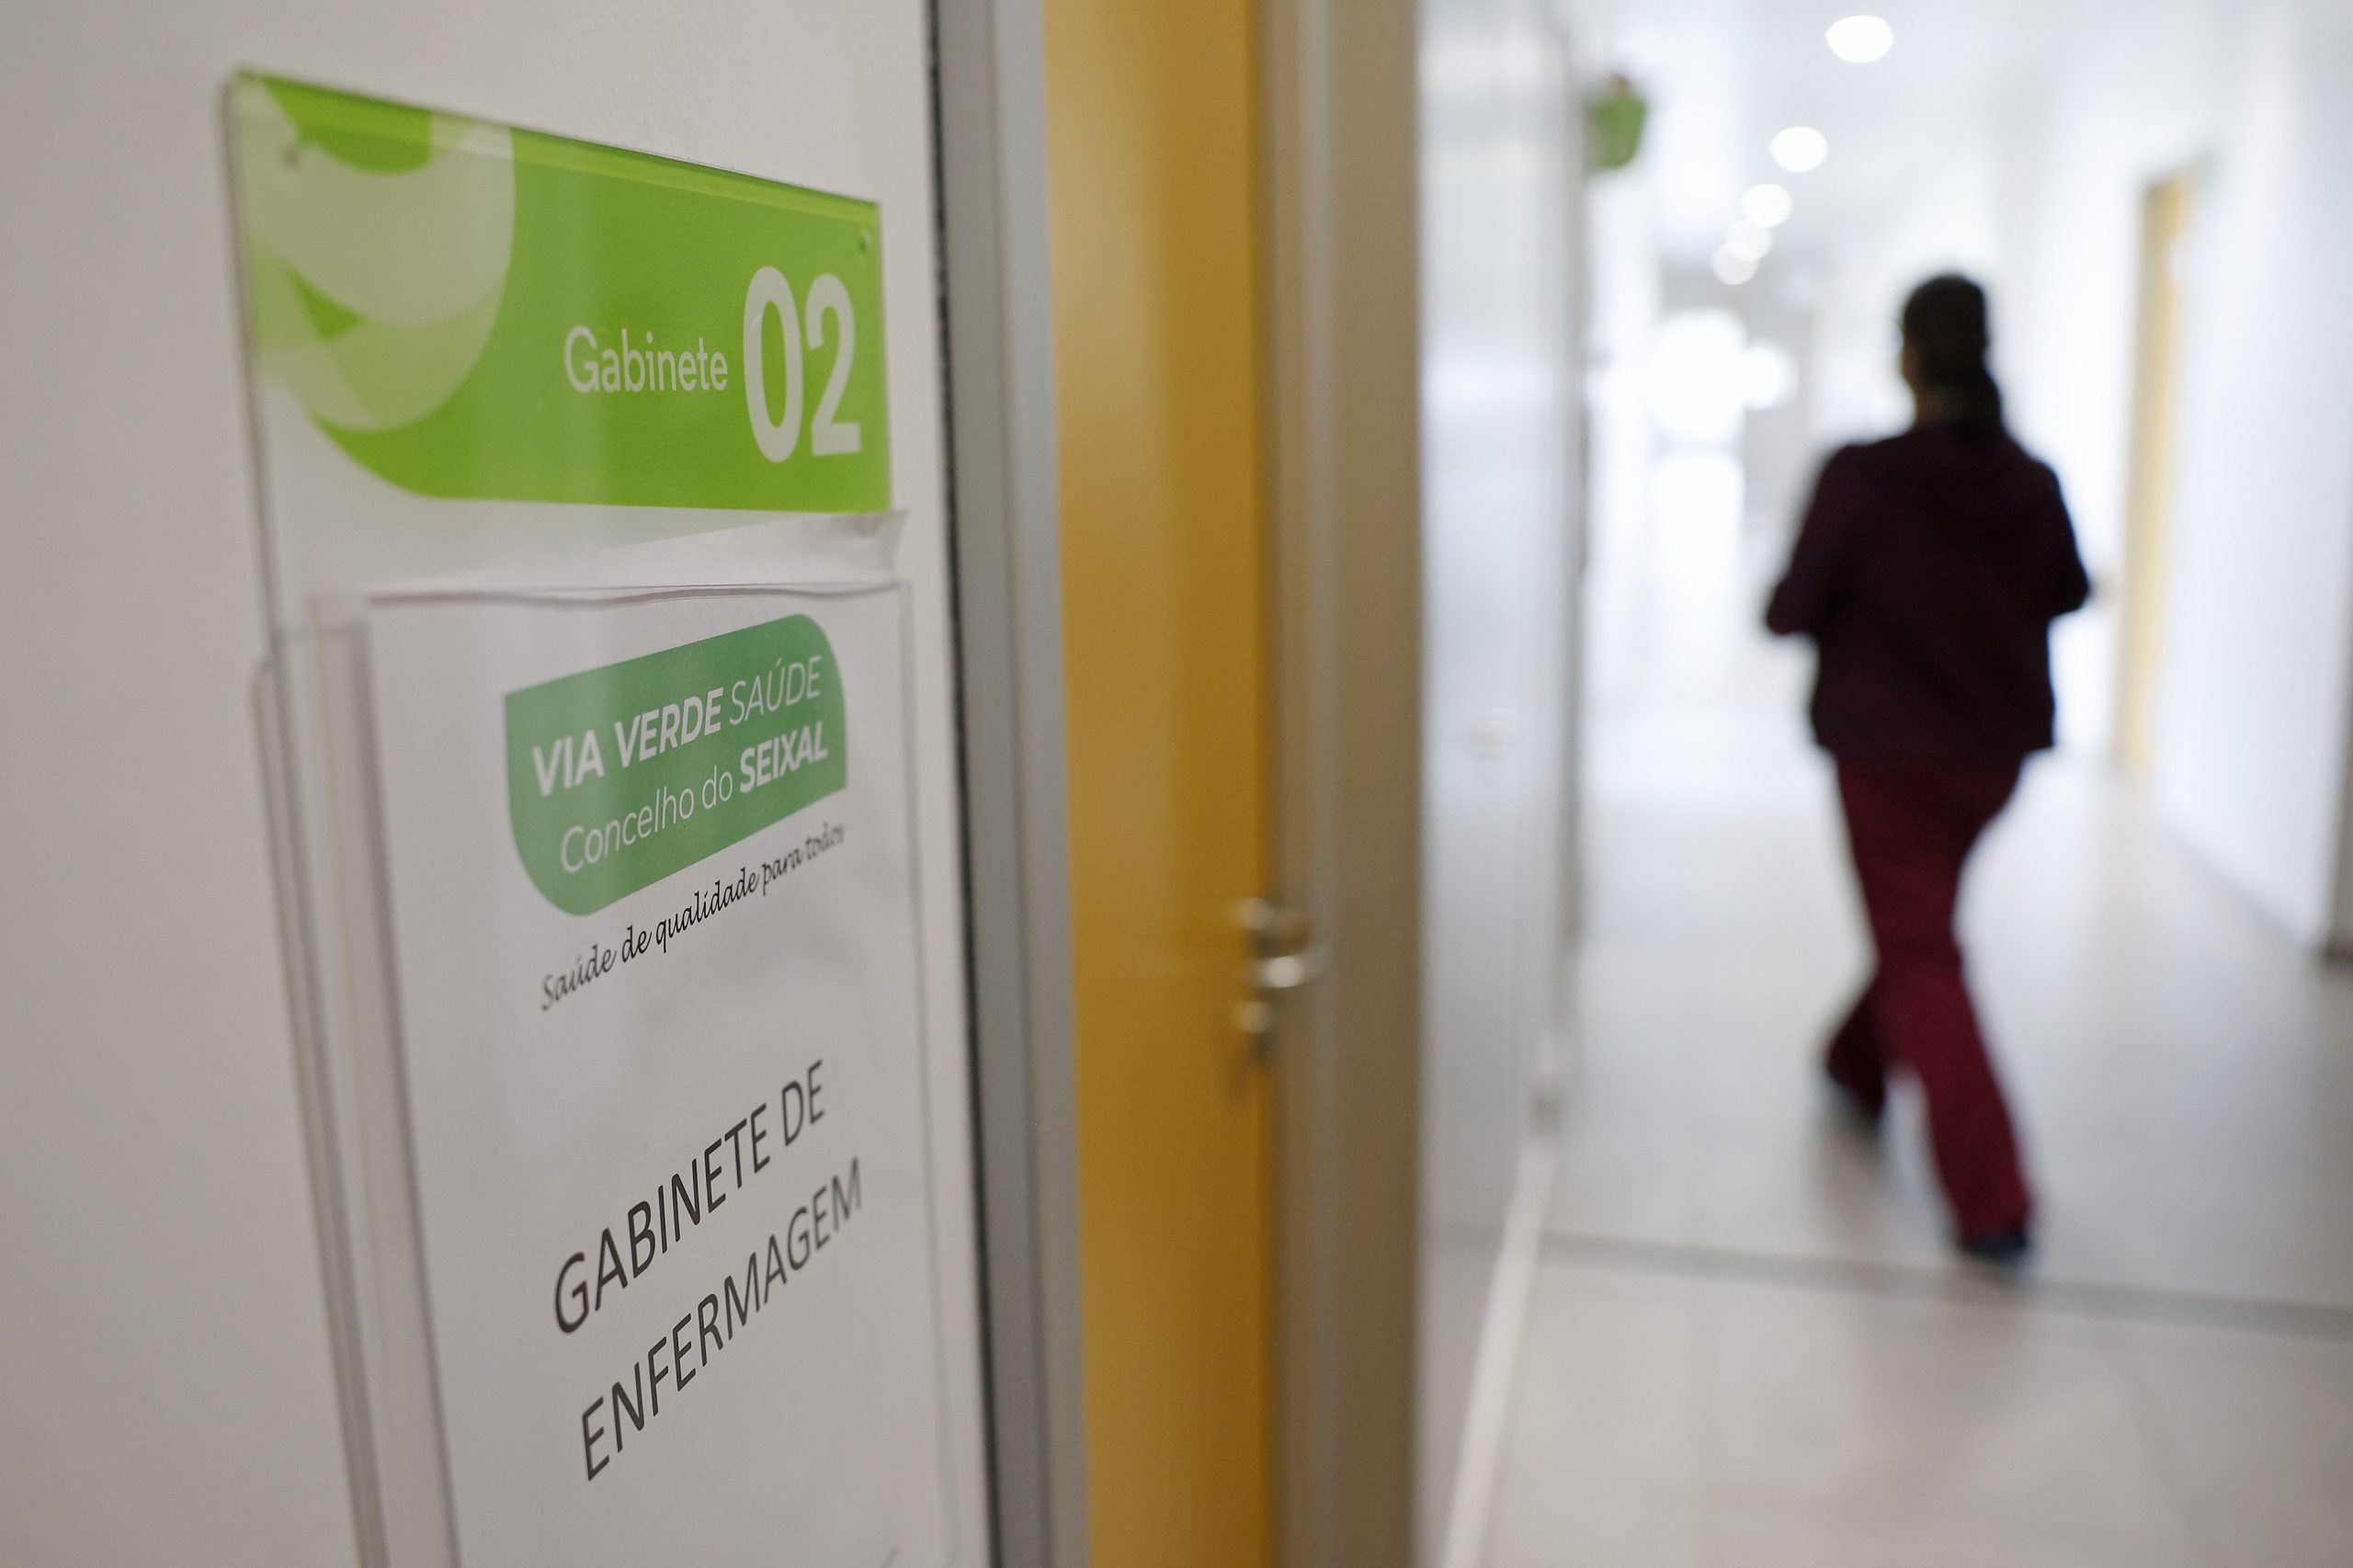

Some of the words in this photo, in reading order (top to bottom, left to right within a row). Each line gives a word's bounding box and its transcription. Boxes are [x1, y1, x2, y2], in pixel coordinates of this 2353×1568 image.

[563, 325, 728, 393] Gabinete
[743, 266, 861, 462] 02
[532, 730, 606, 798] VIA
[614, 687, 724, 768] VERDE
[729, 654, 823, 726] SAÚDE
[560, 786, 695, 874] Concelho
[701, 765, 733, 810] do
[739, 721, 828, 793] SEIXAL
[540, 944, 618, 1012] Saúde
[621, 925, 653, 964] de
[655, 868, 760, 953] qualidade
[760, 846, 804, 896] para
[554, 1103, 771, 1335] GABINETE
[781, 1059, 825, 1147] DE
[581, 1154, 862, 1483] ENFERMAGEM
